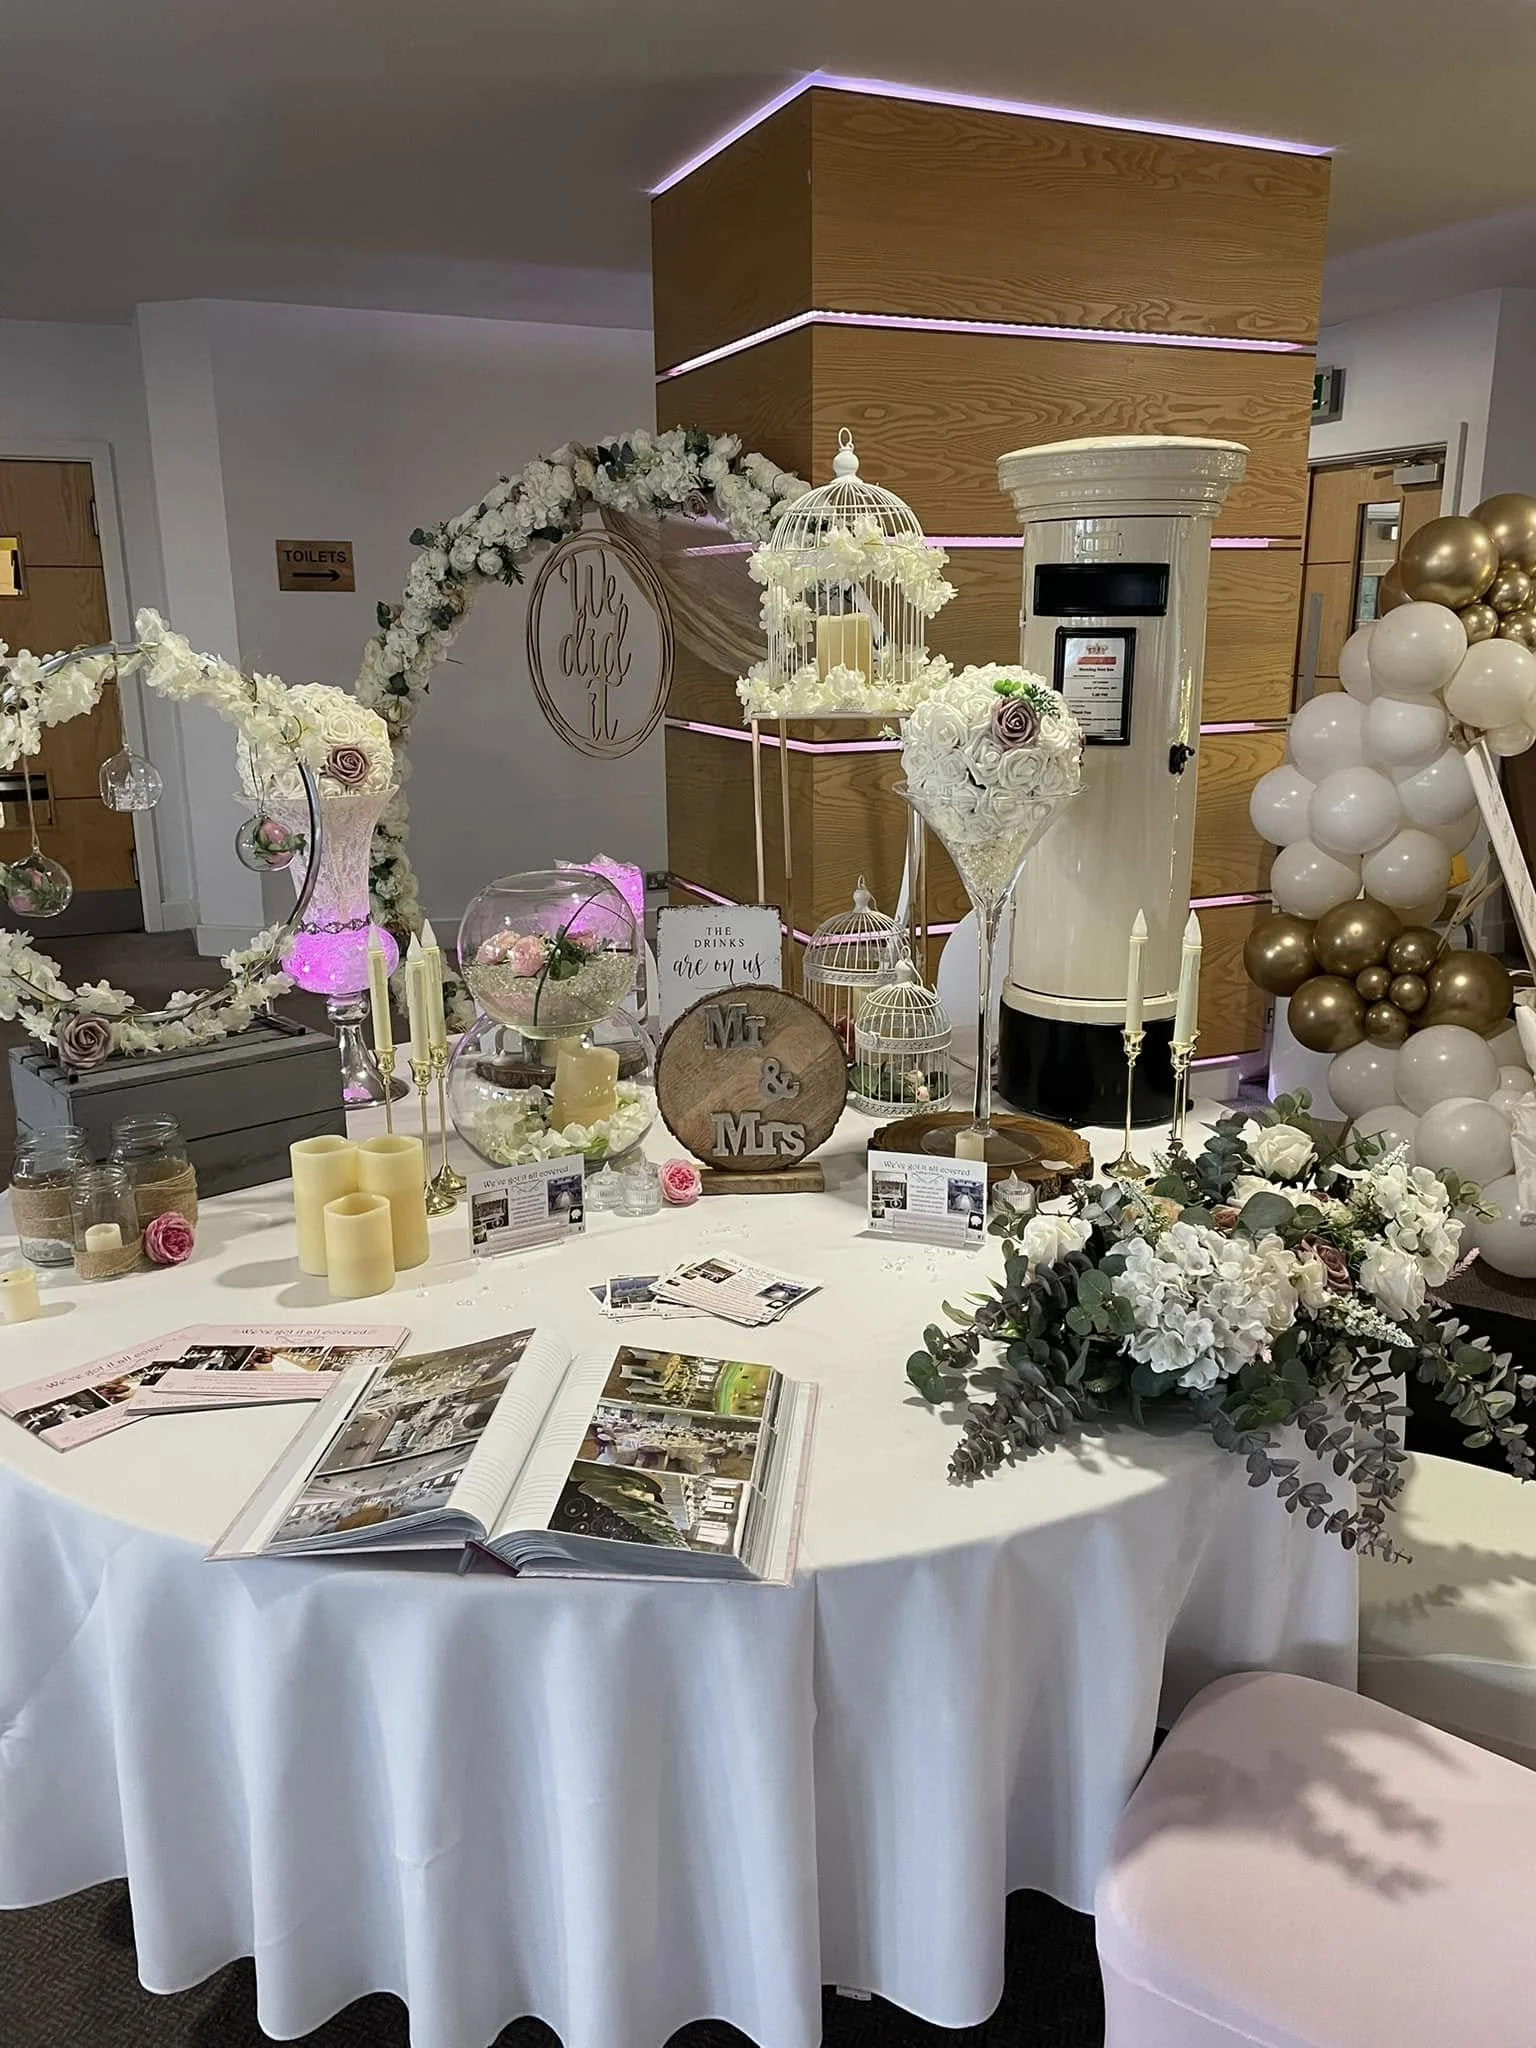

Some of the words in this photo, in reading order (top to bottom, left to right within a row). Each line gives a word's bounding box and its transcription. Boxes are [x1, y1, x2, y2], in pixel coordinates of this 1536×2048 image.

[283, 550, 346, 563] TOILETS
[560, 549, 622, 617] We
[558, 603, 632, 677] did
[587, 676, 621, 741] it
[694, 938, 745, 948] DRINKS
[706, 926, 732, 936] THE
[673, 953, 709, 980] are
[714, 958, 736, 987] on
[742, 952, 766, 980] us
[704, 1003, 768, 1050] Mr
[760, 1057, 800, 1099] &
[711, 1111, 807, 1158] Mrs
[508, 1175, 520, 1186] got
[528, 1171, 538, 1180] all
[539, 1167, 569, 1178] covered
[883, 1160, 906, 1170] We've
[908, 1163, 920, 1171] got
[940, 1167, 970, 1176] covered
[274, 1328, 294, 1336] got
[84, 1364, 104, 1377] got
[117, 1354, 132, 1364] all
